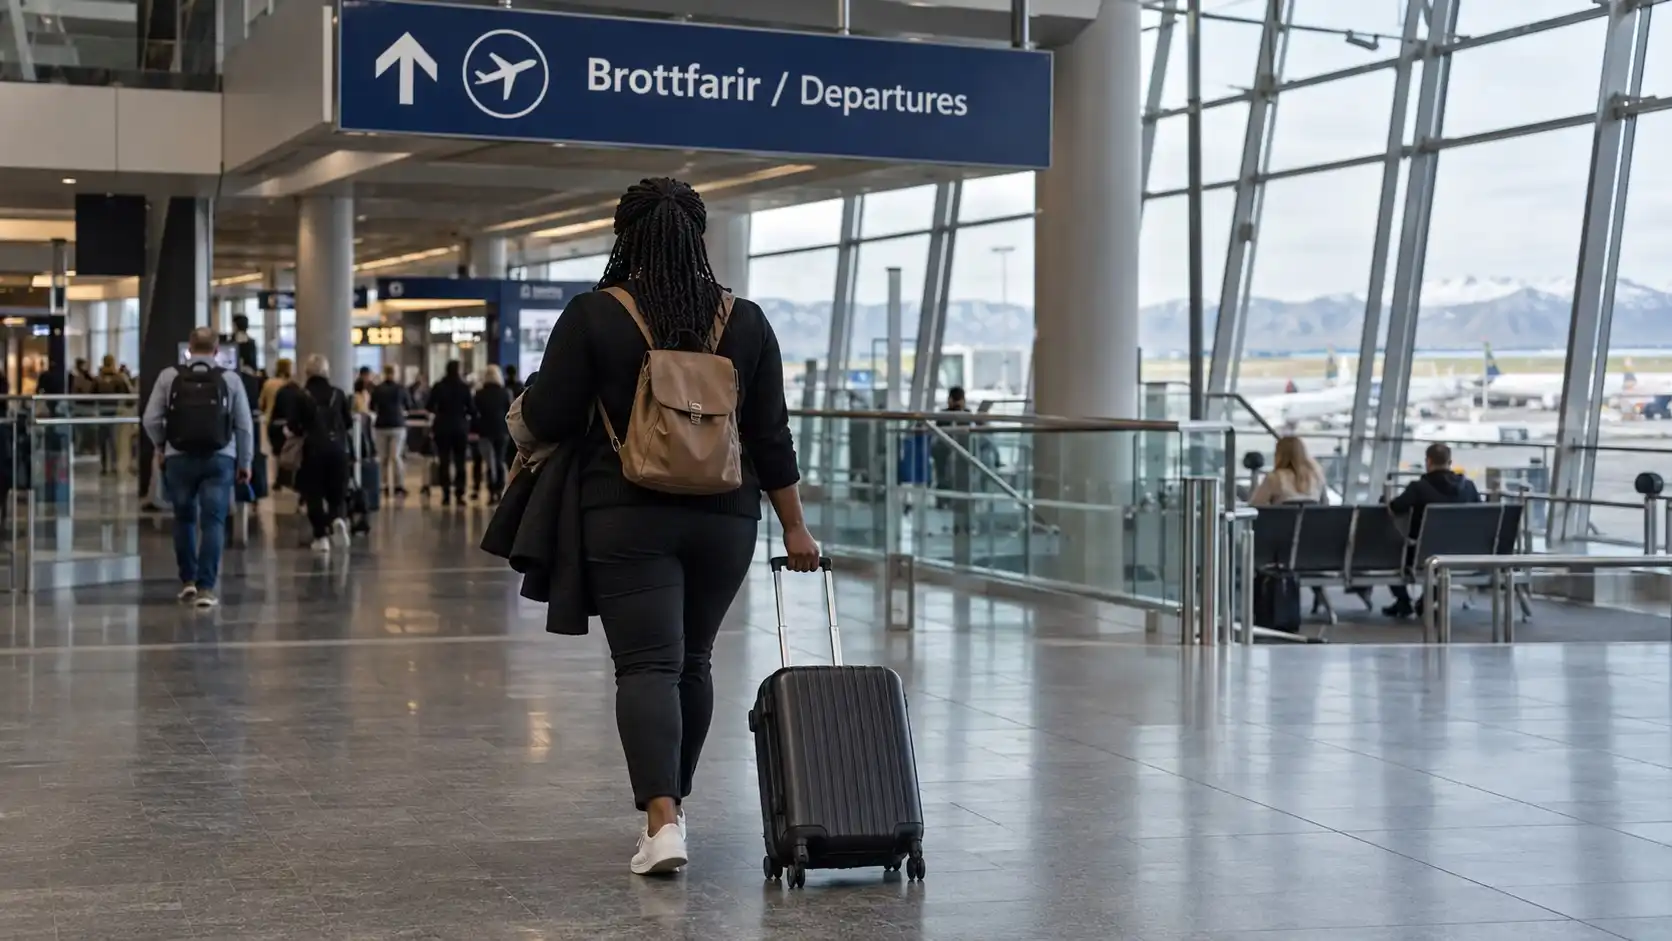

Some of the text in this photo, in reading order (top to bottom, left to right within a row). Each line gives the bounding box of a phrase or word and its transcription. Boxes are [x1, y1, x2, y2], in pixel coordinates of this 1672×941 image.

[588, 57, 969, 117] Brottfarir / Departures
